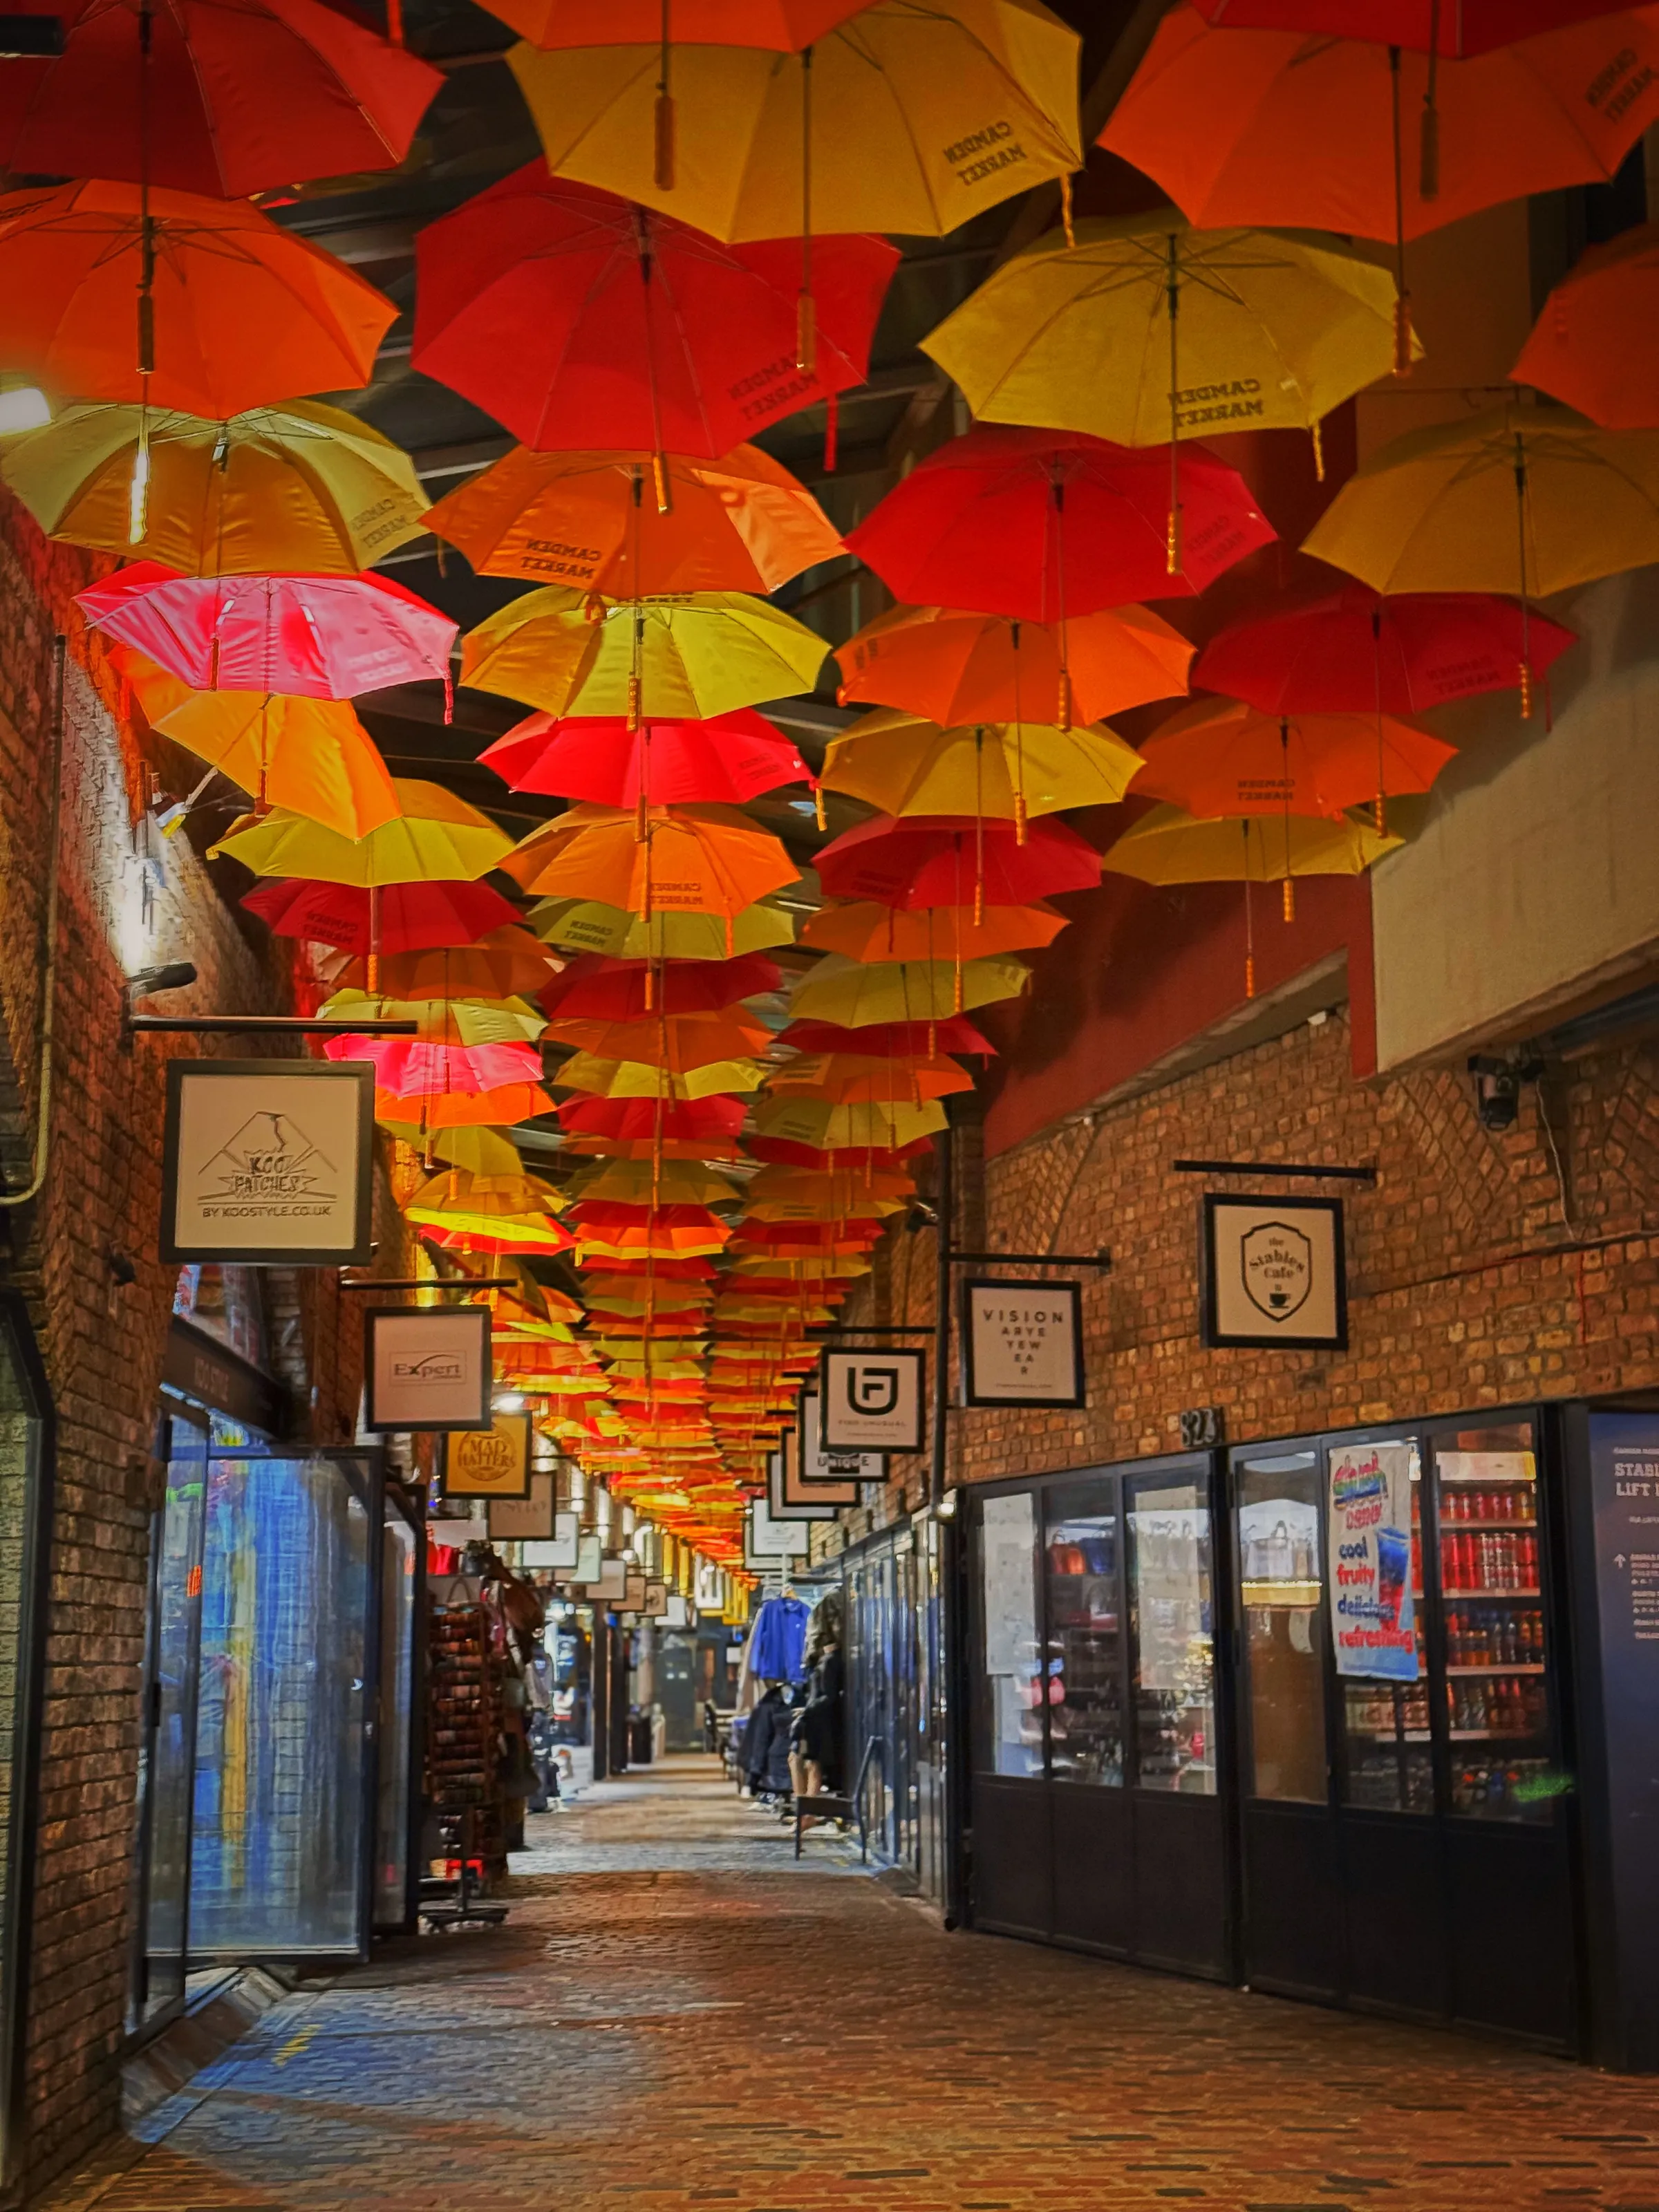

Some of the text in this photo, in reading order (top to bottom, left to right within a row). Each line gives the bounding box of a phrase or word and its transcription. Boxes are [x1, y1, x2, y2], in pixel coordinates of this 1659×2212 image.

[250, 1156, 288, 1174] KOO
[234, 1174, 299, 1192] PATCHES
[203, 1206, 331, 1217] BY KOOSTYLE.CO.UK
[982, 1309, 1064, 1323] VISION
[393, 1361, 460, 1378] Expert
[471, 1439, 507, 1456] MAD
[458, 1453, 516, 1468] HATTERS
[817, 1455, 870, 1469] UNIQUE
[1615, 1481, 1651, 1497] LIFT
[1338, 1536, 1368, 1559] cool
[1336, 1564, 1375, 1590] fruity
